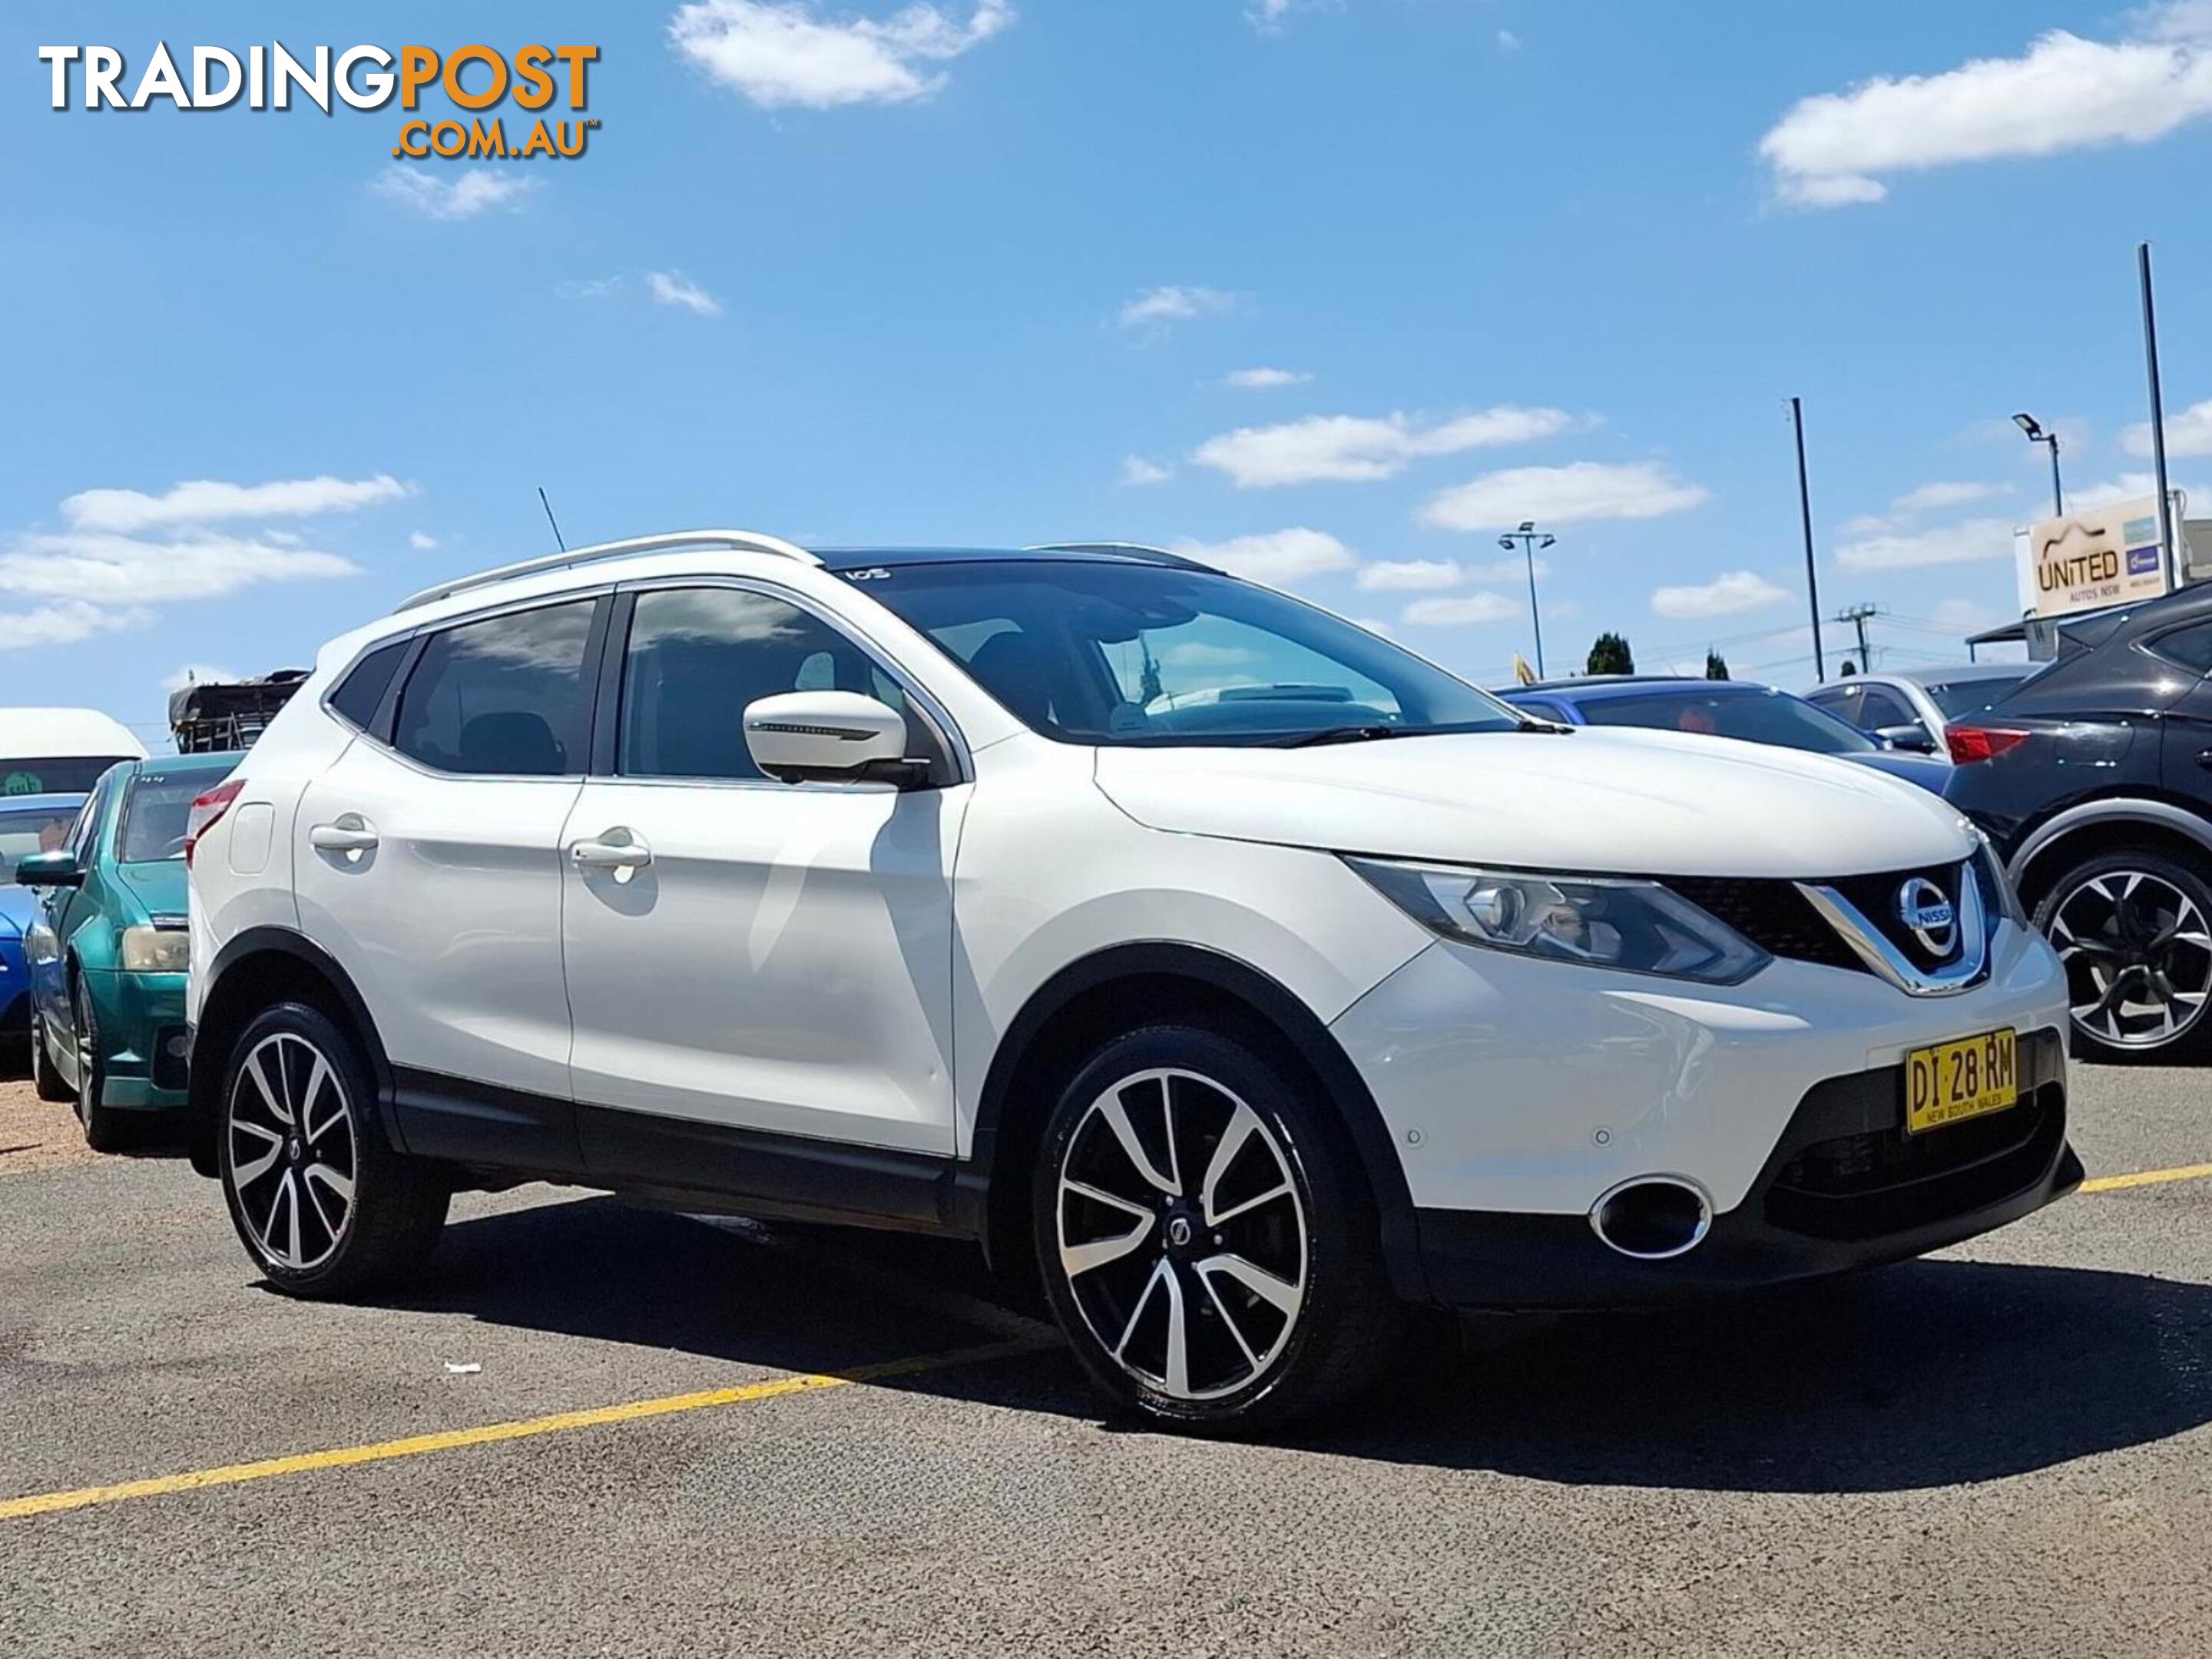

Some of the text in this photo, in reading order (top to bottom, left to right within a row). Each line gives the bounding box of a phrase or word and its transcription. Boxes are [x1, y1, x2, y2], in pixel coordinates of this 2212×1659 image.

[2069, 584, 2121, 602] AUTOS NSW
[1918, 909, 1951, 925] NISS
[1926, 1093, 2002, 1122] NEW SOUTH WALES
